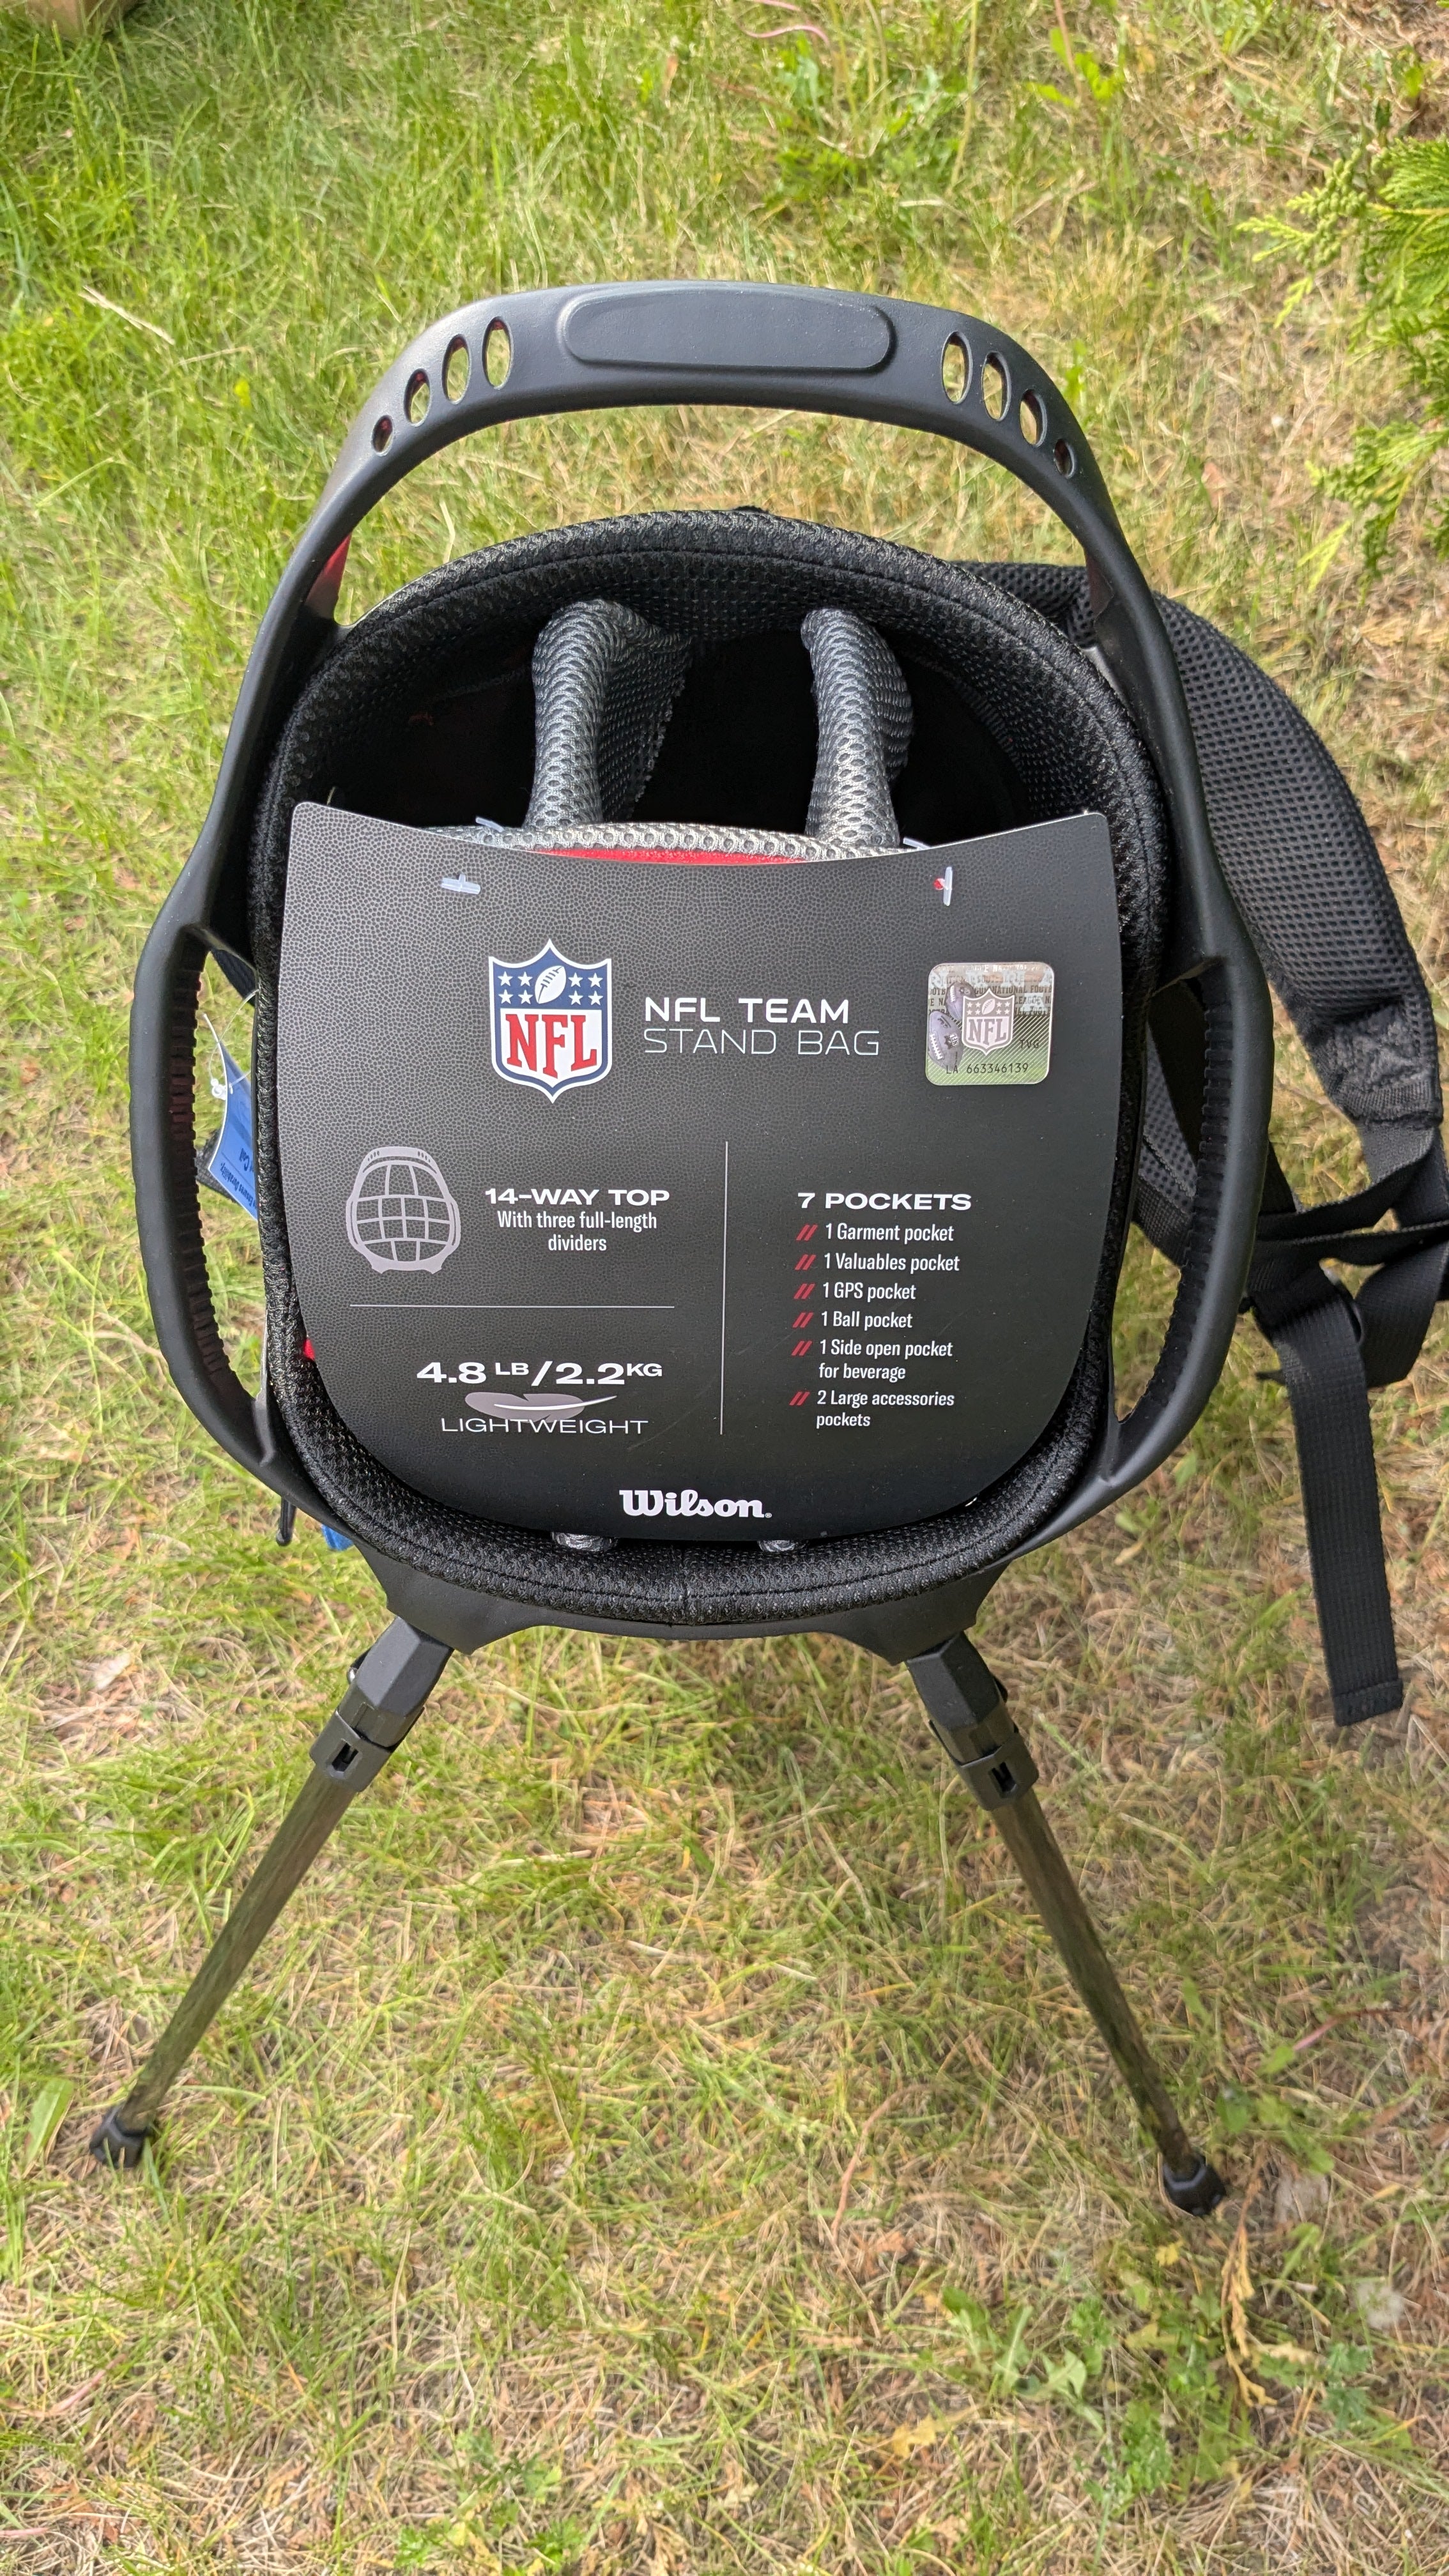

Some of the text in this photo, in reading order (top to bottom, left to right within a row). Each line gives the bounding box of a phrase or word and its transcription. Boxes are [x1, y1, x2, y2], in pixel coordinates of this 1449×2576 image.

[645, 996, 849, 1024] NFL TEAM
[643, 1028, 880, 1055] STAND BAG
[967, 1018, 1008, 1046] NFL
[503, 1013, 598, 1078] NFL
[946, 1062, 1029, 1074] LA 663346139
[484, 1188, 670, 1206] 14-WAY TOP
[797, 1192, 972, 1211] 7 POCKETS
[496, 1210, 657, 1233] With three full-length
[548, 1234, 607, 1252] dividers
[825, 1222, 954, 1245] 1 Garment pocket
[824, 1252, 960, 1275] 1 Valuables pocket
[823, 1282, 917, 1303] 1 GPS pocket
[821, 1310, 913, 1331] 1 Ball pocket
[820, 1338, 953, 1360] 1 Side open pocket
[417, 1361, 487, 1384] 4.8
[818, 1362, 906, 1383] for beverage
[816, 1390, 954, 1409] 2 Large accessories
[441, 1418, 648, 1434] LIGHTWEIGHT
[816, 1412, 871, 1429] pockets
